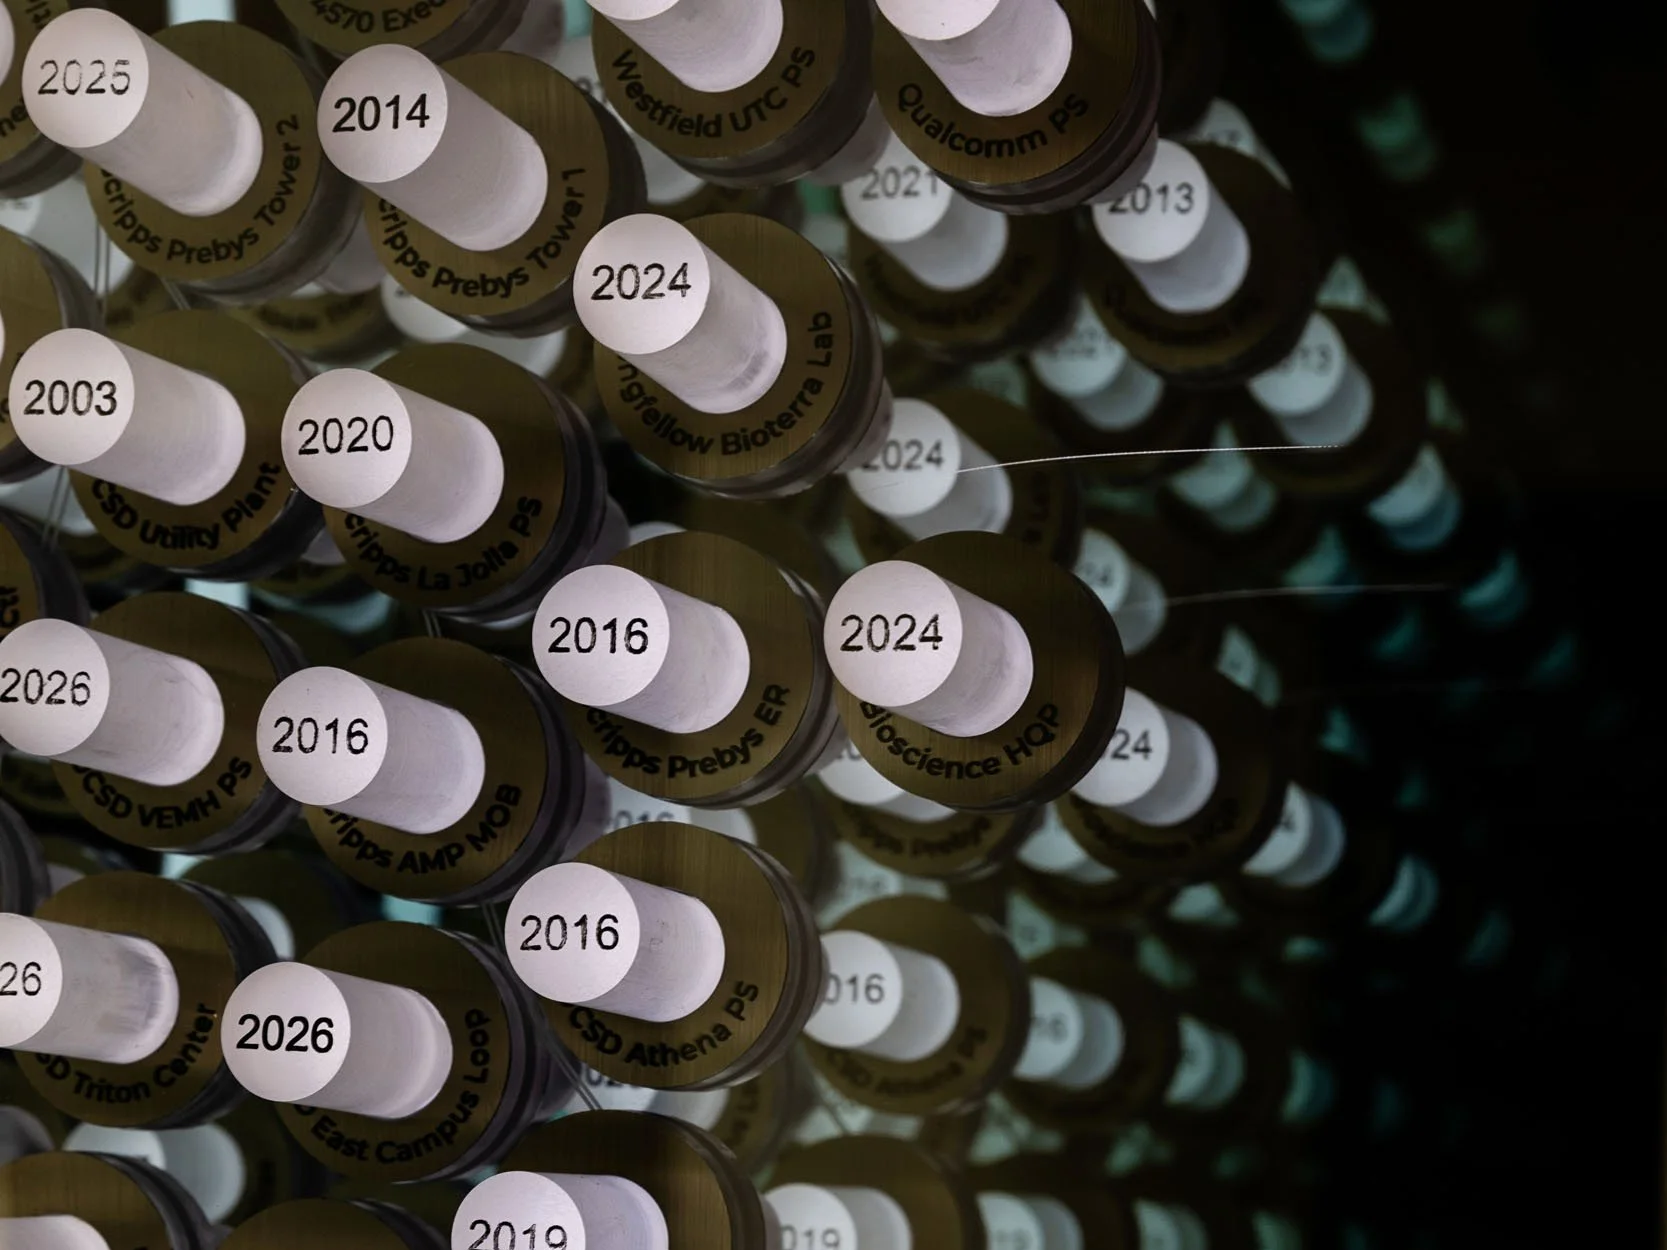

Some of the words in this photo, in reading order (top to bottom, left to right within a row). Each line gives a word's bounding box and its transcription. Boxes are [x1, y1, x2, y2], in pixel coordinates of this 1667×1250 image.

[38, 59, 131, 95] 2025
[612, 49, 722, 138] Westfield
[729, 86, 788, 132] UTC
[781, 47, 815, 88] PS
[276, 114, 299, 136] 2
[332, 93, 430, 132] 2014
[898, 83, 1047, 157] Qualcomm
[1048, 93, 1089, 133] PS
[100, 168, 162, 254] cripps
[254, 143, 301, 226] Tower
[166, 226, 259, 264] Prebys
[379, 198, 431, 278] cripps
[432, 266, 530, 298] Prebys
[526, 186, 585, 270] Tower
[591, 262, 691, 299] 2024
[24, 380, 117, 415] 2003
[617, 354, 714, 455] ngfellow
[721, 377, 824, 455] Bioterra
[807, 311, 834, 367] Lab
[298, 416, 394, 455] 2020
[91, 479, 137, 529] CSD
[140, 519, 220, 550] Utility
[222, 462, 281, 532] Plant
[344, 512, 409, 583] cripps
[417, 566, 449, 590] La
[454, 540, 519, 587] Jolla
[510, 496, 542, 537] PS
[548, 616, 649, 655] 2016
[840, 613, 943, 652] 2024
[0, 668, 90, 706] 2026
[272, 717, 369, 754] 2016
[586, 706, 661, 774] cripps
[668, 728, 764, 778] Prebys
[754, 684, 790, 726] ER
[1003, 703, 1059, 766] HQP
[72, 763, 132, 819] CSD
[138, 791, 221, 829] VEMH
[217, 756, 251, 797] PS
[324, 808, 393, 867] ripps
[397, 842, 465, 874] AMP
[465, 784, 522, 851] MOB
[520, 914, 619, 951] 2016
[826, 974, 885, 1005] 016
[73, 1072, 151, 1104] Triton
[153, 1003, 216, 1088] Center
[236, 1013, 334, 1053] 2026
[570, 1005, 622, 1055] CSD
[624, 1022, 732, 1067] Athena
[725, 980, 759, 1020] PS
[311, 1115, 369, 1161] East
[375, 1090, 480, 1165] Campus
[464, 1008, 490, 1084] Loop
